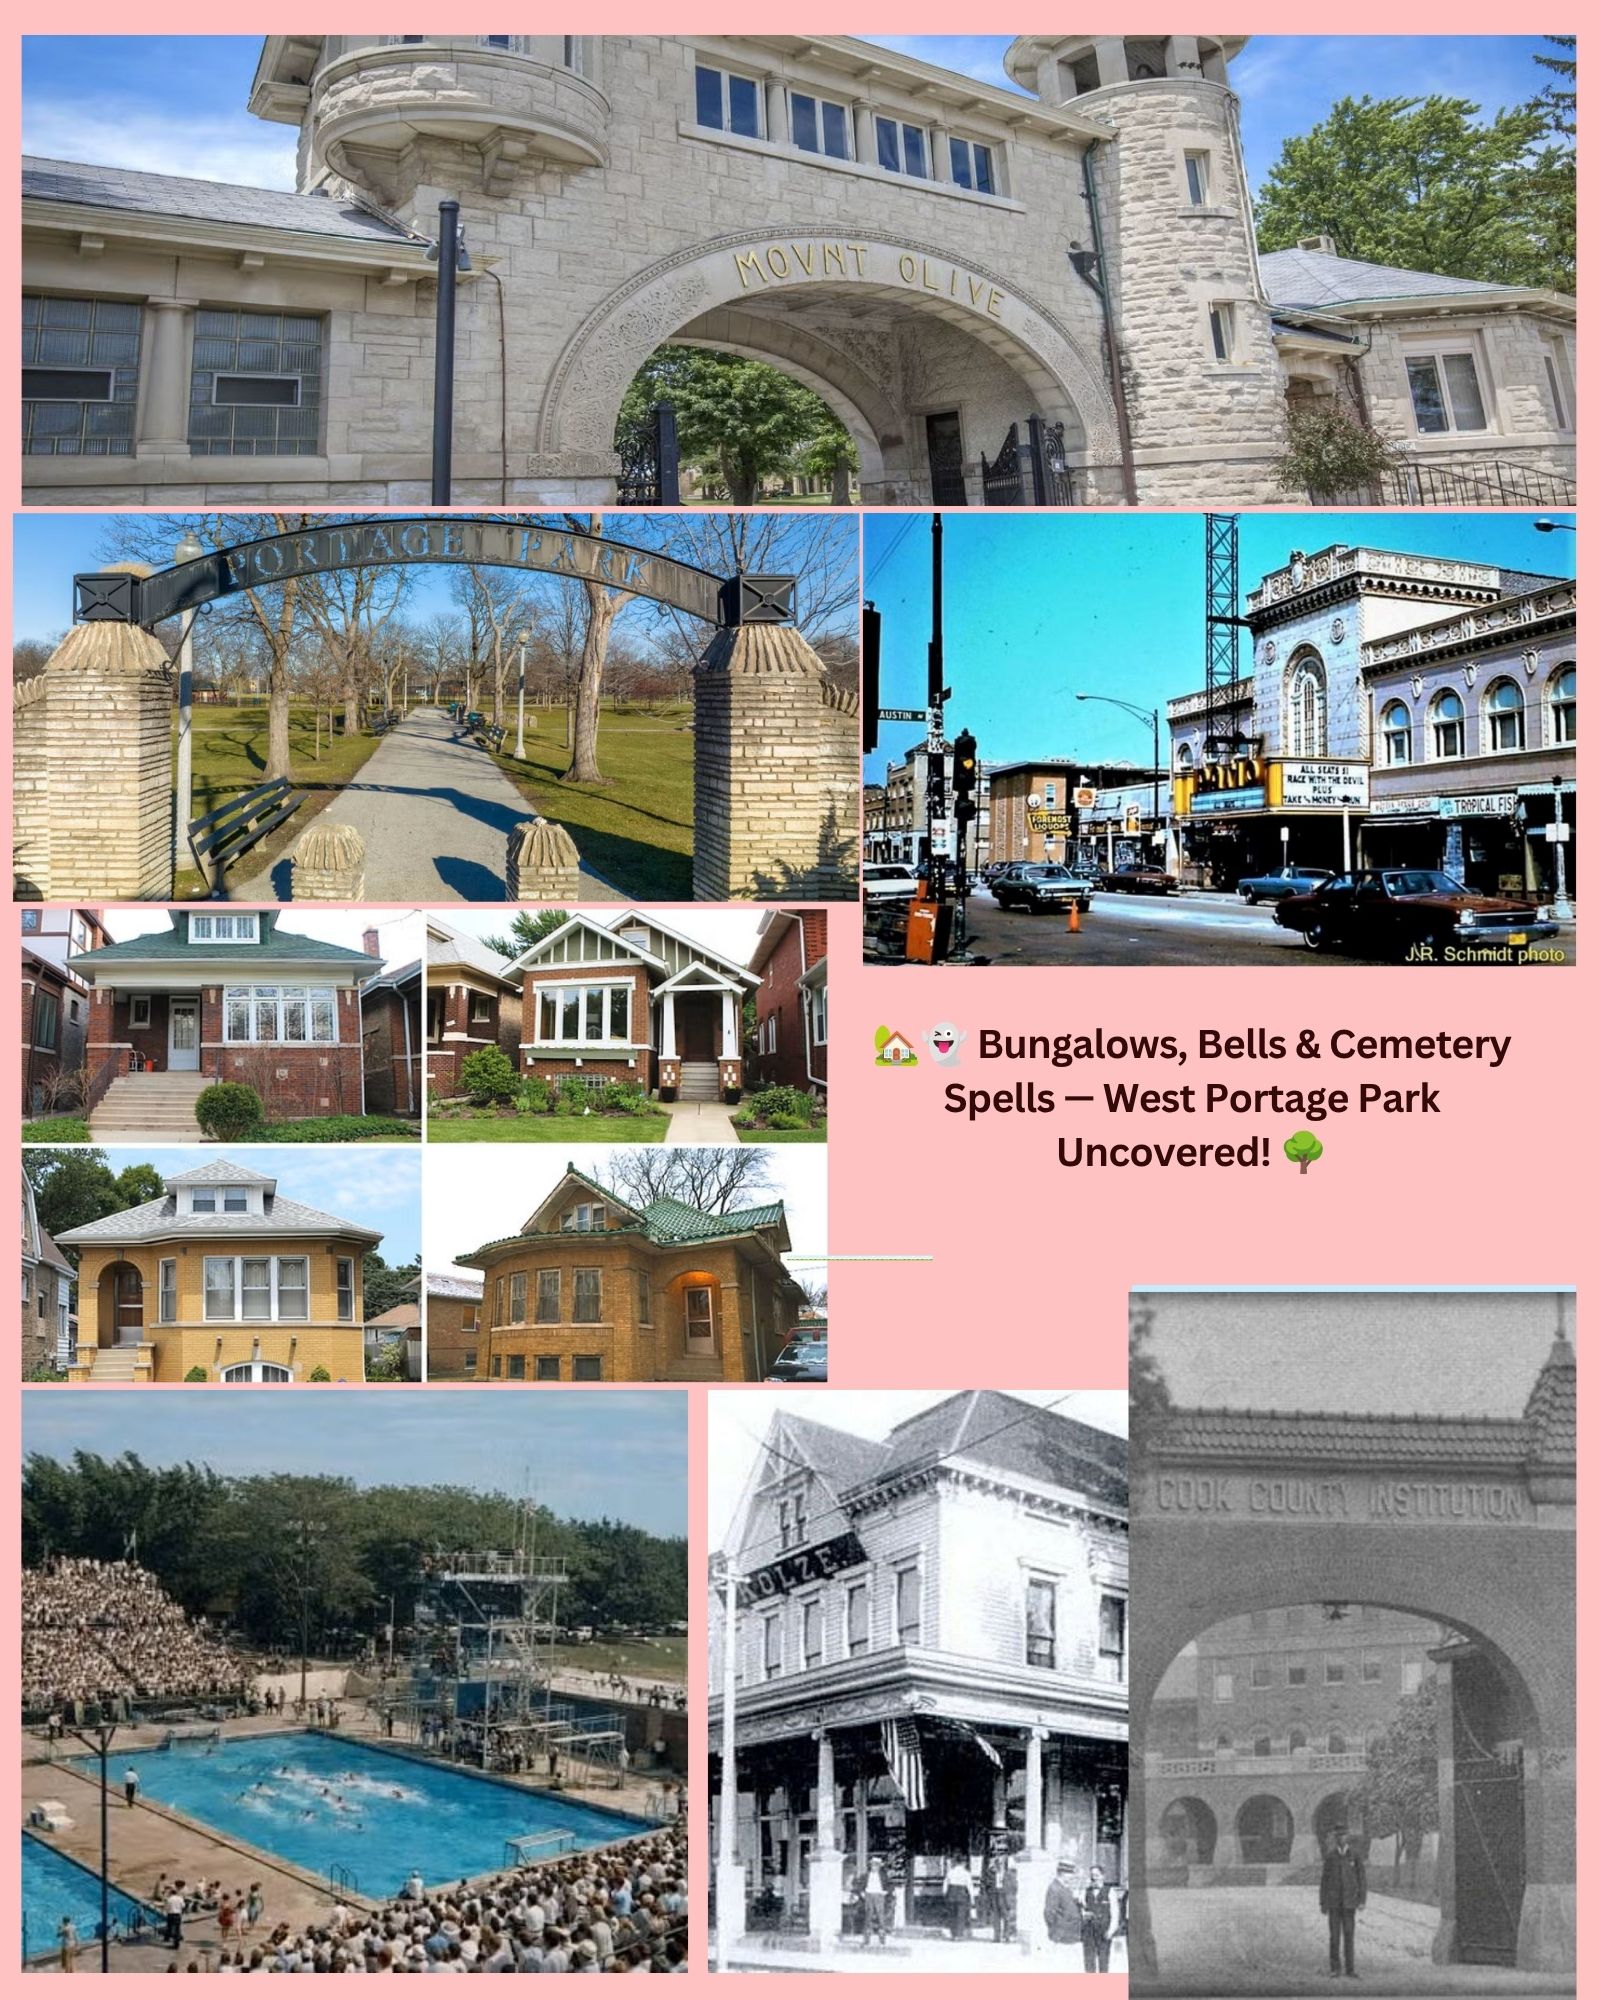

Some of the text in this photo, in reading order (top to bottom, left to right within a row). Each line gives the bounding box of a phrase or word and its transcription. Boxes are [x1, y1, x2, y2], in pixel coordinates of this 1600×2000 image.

[899, 254, 1005, 318] OLIVE
[223, 524, 652, 589] PORTAGE PARK
[879, 710, 912, 720] AUSTIN
[1301, 765, 1315, 774] ALL
[1318, 766, 1339, 775] SEATS
[1287, 775, 1364, 785] RACE WITH THE DEVIL
[1313, 786, 1332, 794] PLUS
[1283, 795, 1302, 804] TAKE
[1312, 796, 1336, 804] MONEY
[1455, 795, 1496, 814] TROPICAL
[1032, 815, 1072, 823] FOREMOST
[1156, 1478, 1523, 1519] COOK COUNTY INSTITUTION
